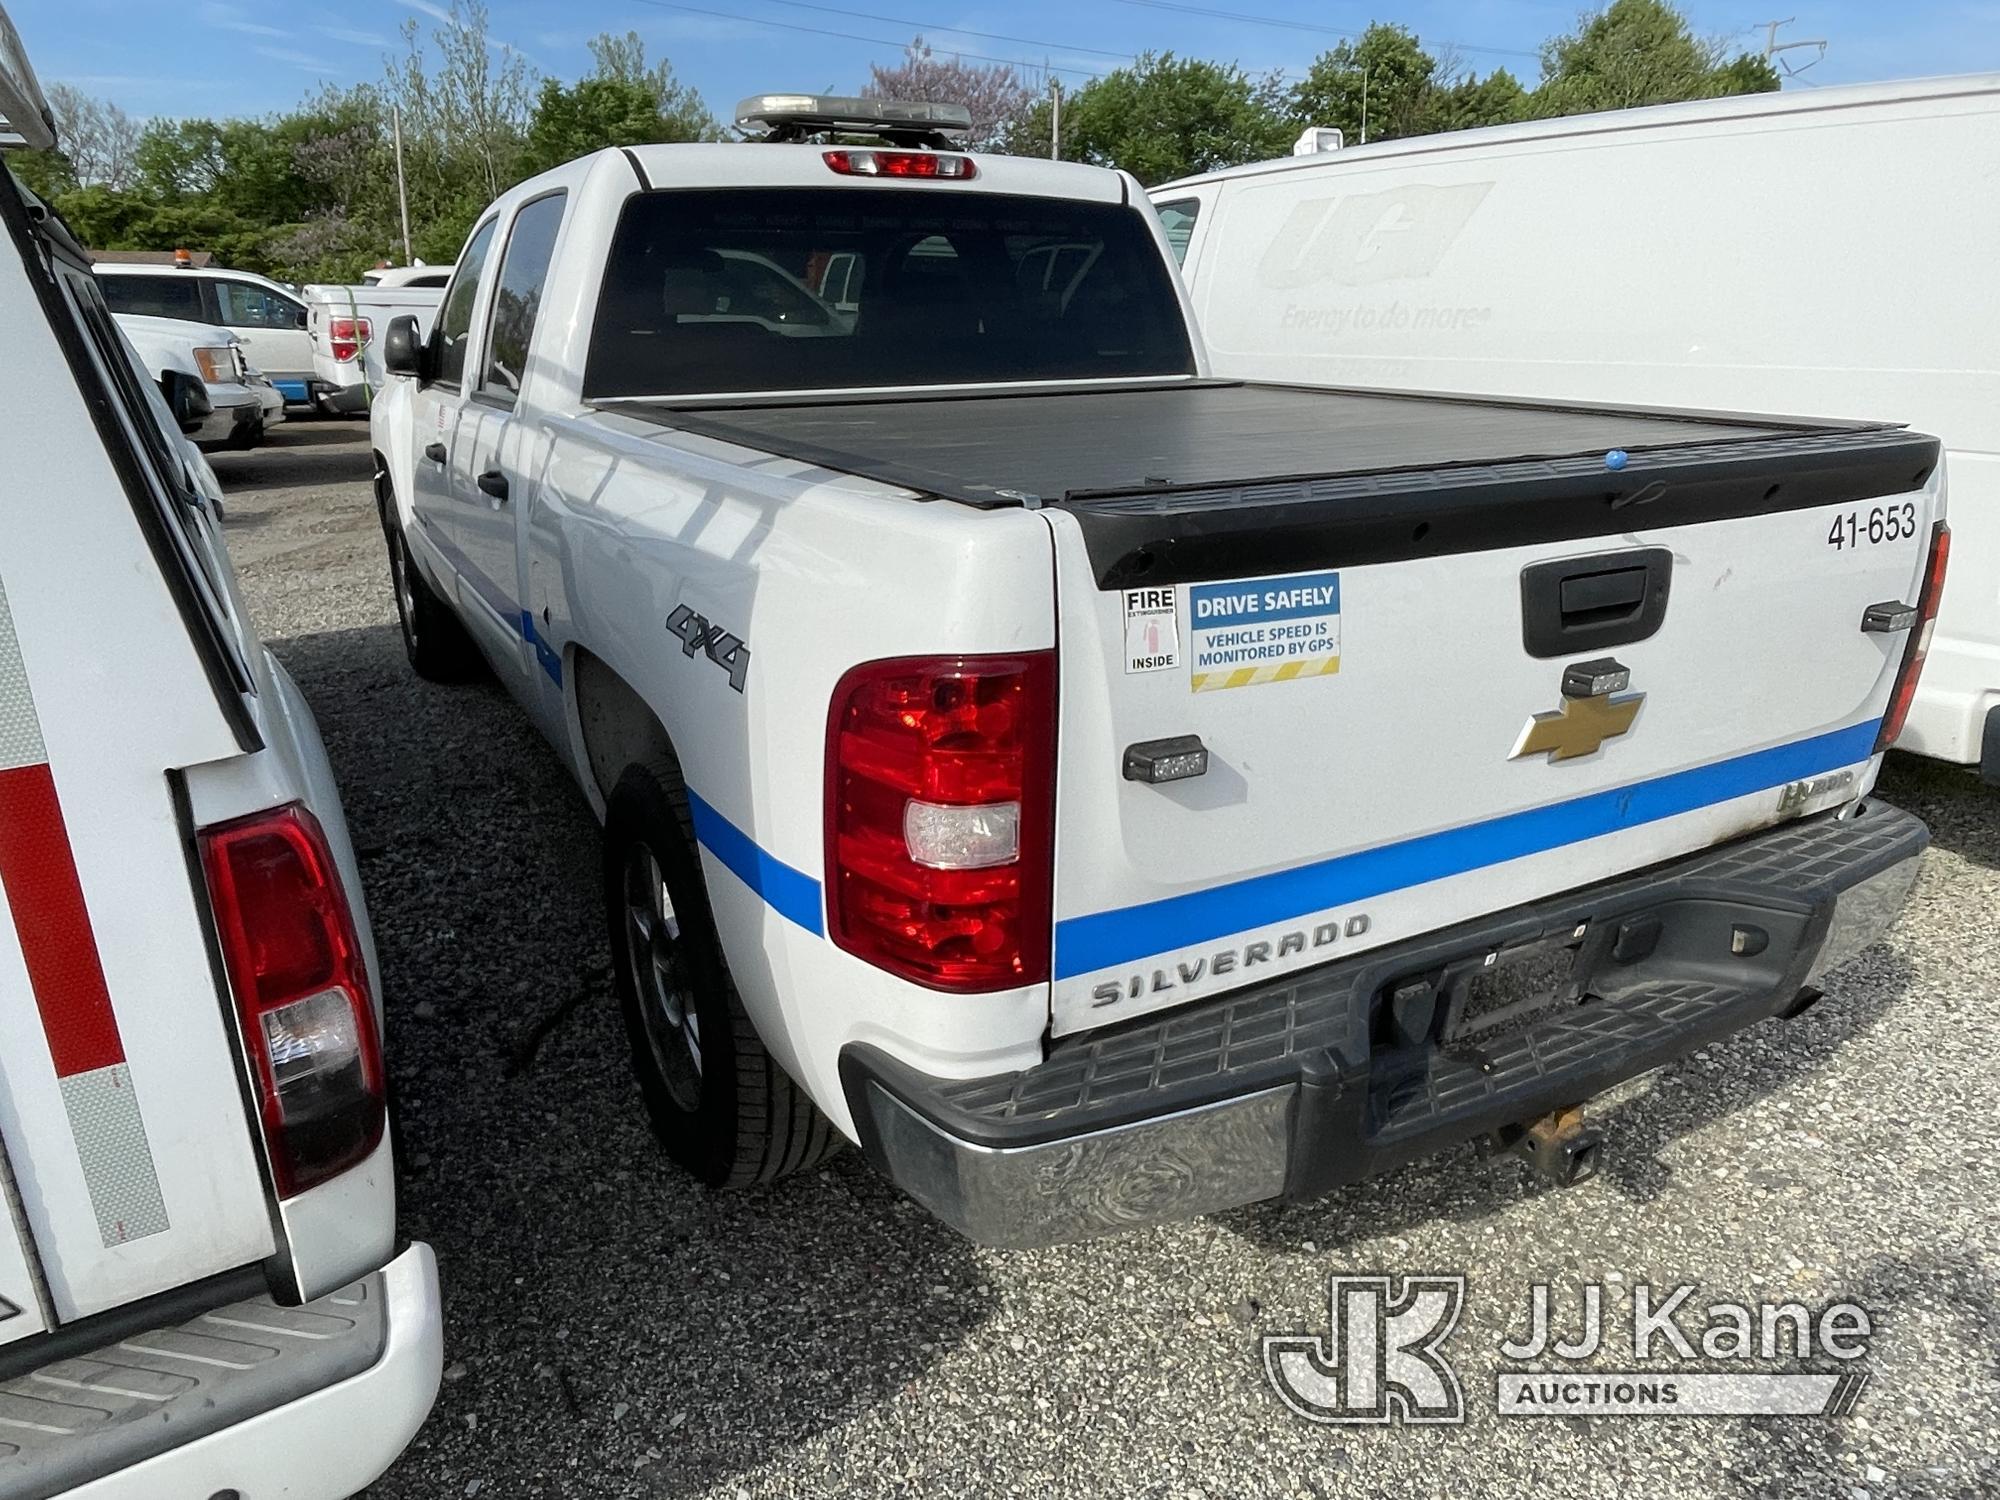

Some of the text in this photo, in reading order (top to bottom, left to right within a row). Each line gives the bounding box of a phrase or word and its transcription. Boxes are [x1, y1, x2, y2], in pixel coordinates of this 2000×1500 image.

[1828, 502, 1916, 551] 41-653
[1128, 589, 1173, 610] FIRE
[1197, 586, 1334, 618] DRIVE SAFELY
[665, 603, 751, 695] 4X4
[1206, 622, 1328, 648] VEHICLE SPEED IS
[1132, 654, 1174, 670] INSIDE
[1199, 637, 1334, 666] MONITORED BY GPS
[1091, 912, 1372, 1009] SILVERADO
